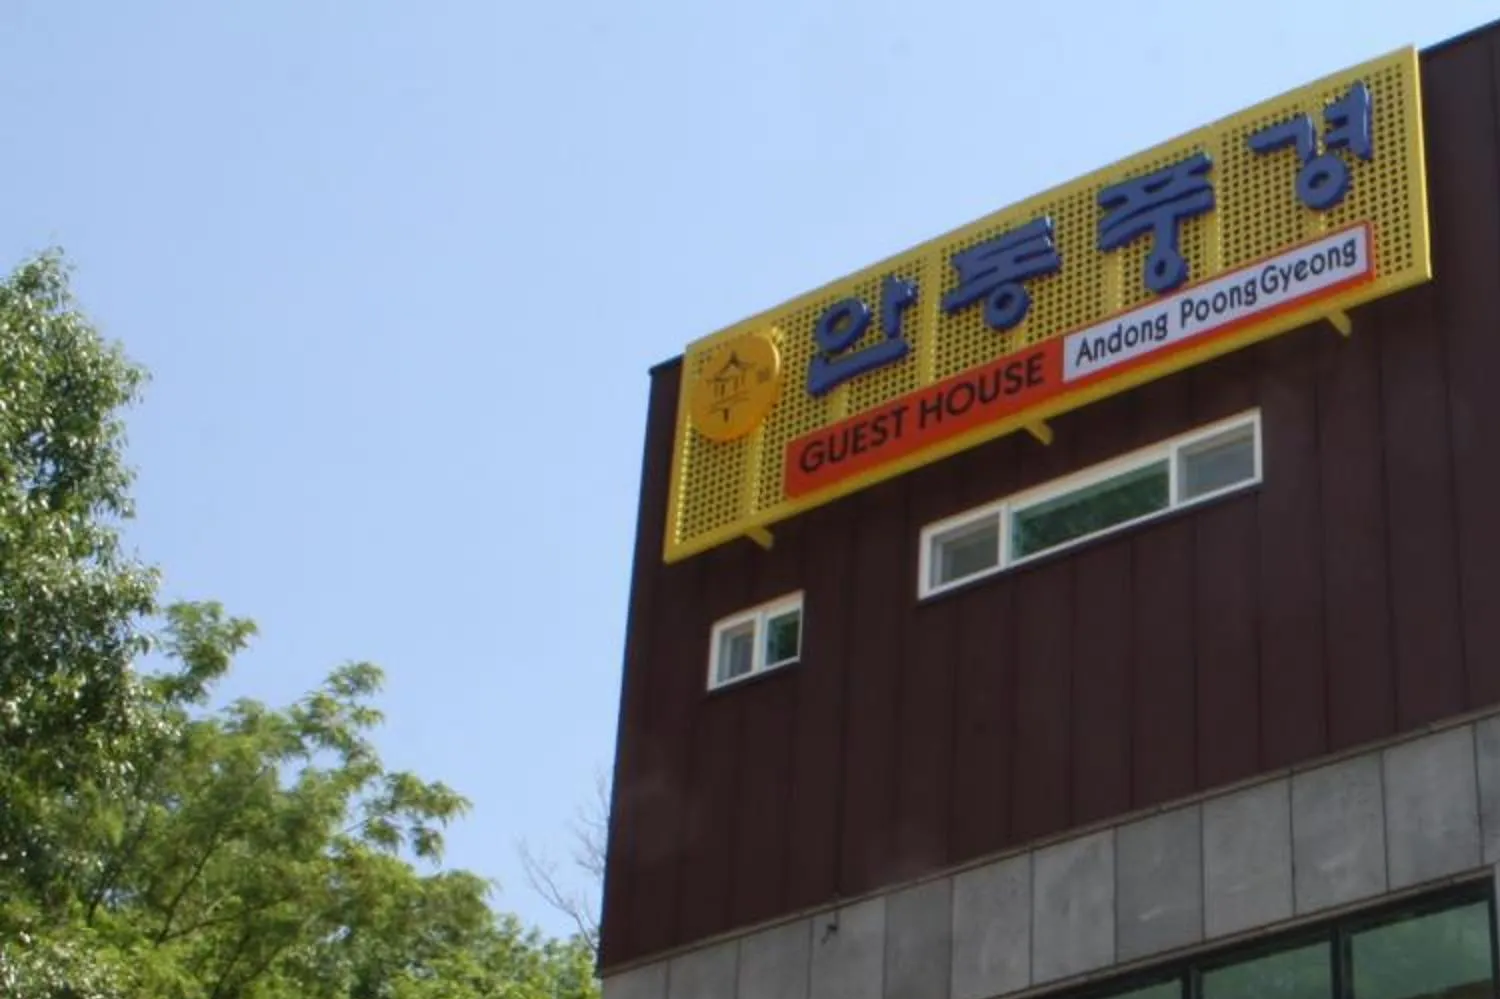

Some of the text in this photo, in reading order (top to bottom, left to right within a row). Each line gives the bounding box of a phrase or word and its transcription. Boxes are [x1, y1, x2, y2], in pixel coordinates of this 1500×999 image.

[807, 80, 1373, 397] 안동풍경
[1075, 312, 1169, 368] Andong
[800, 352, 1046, 473] GUEST HOUSE
